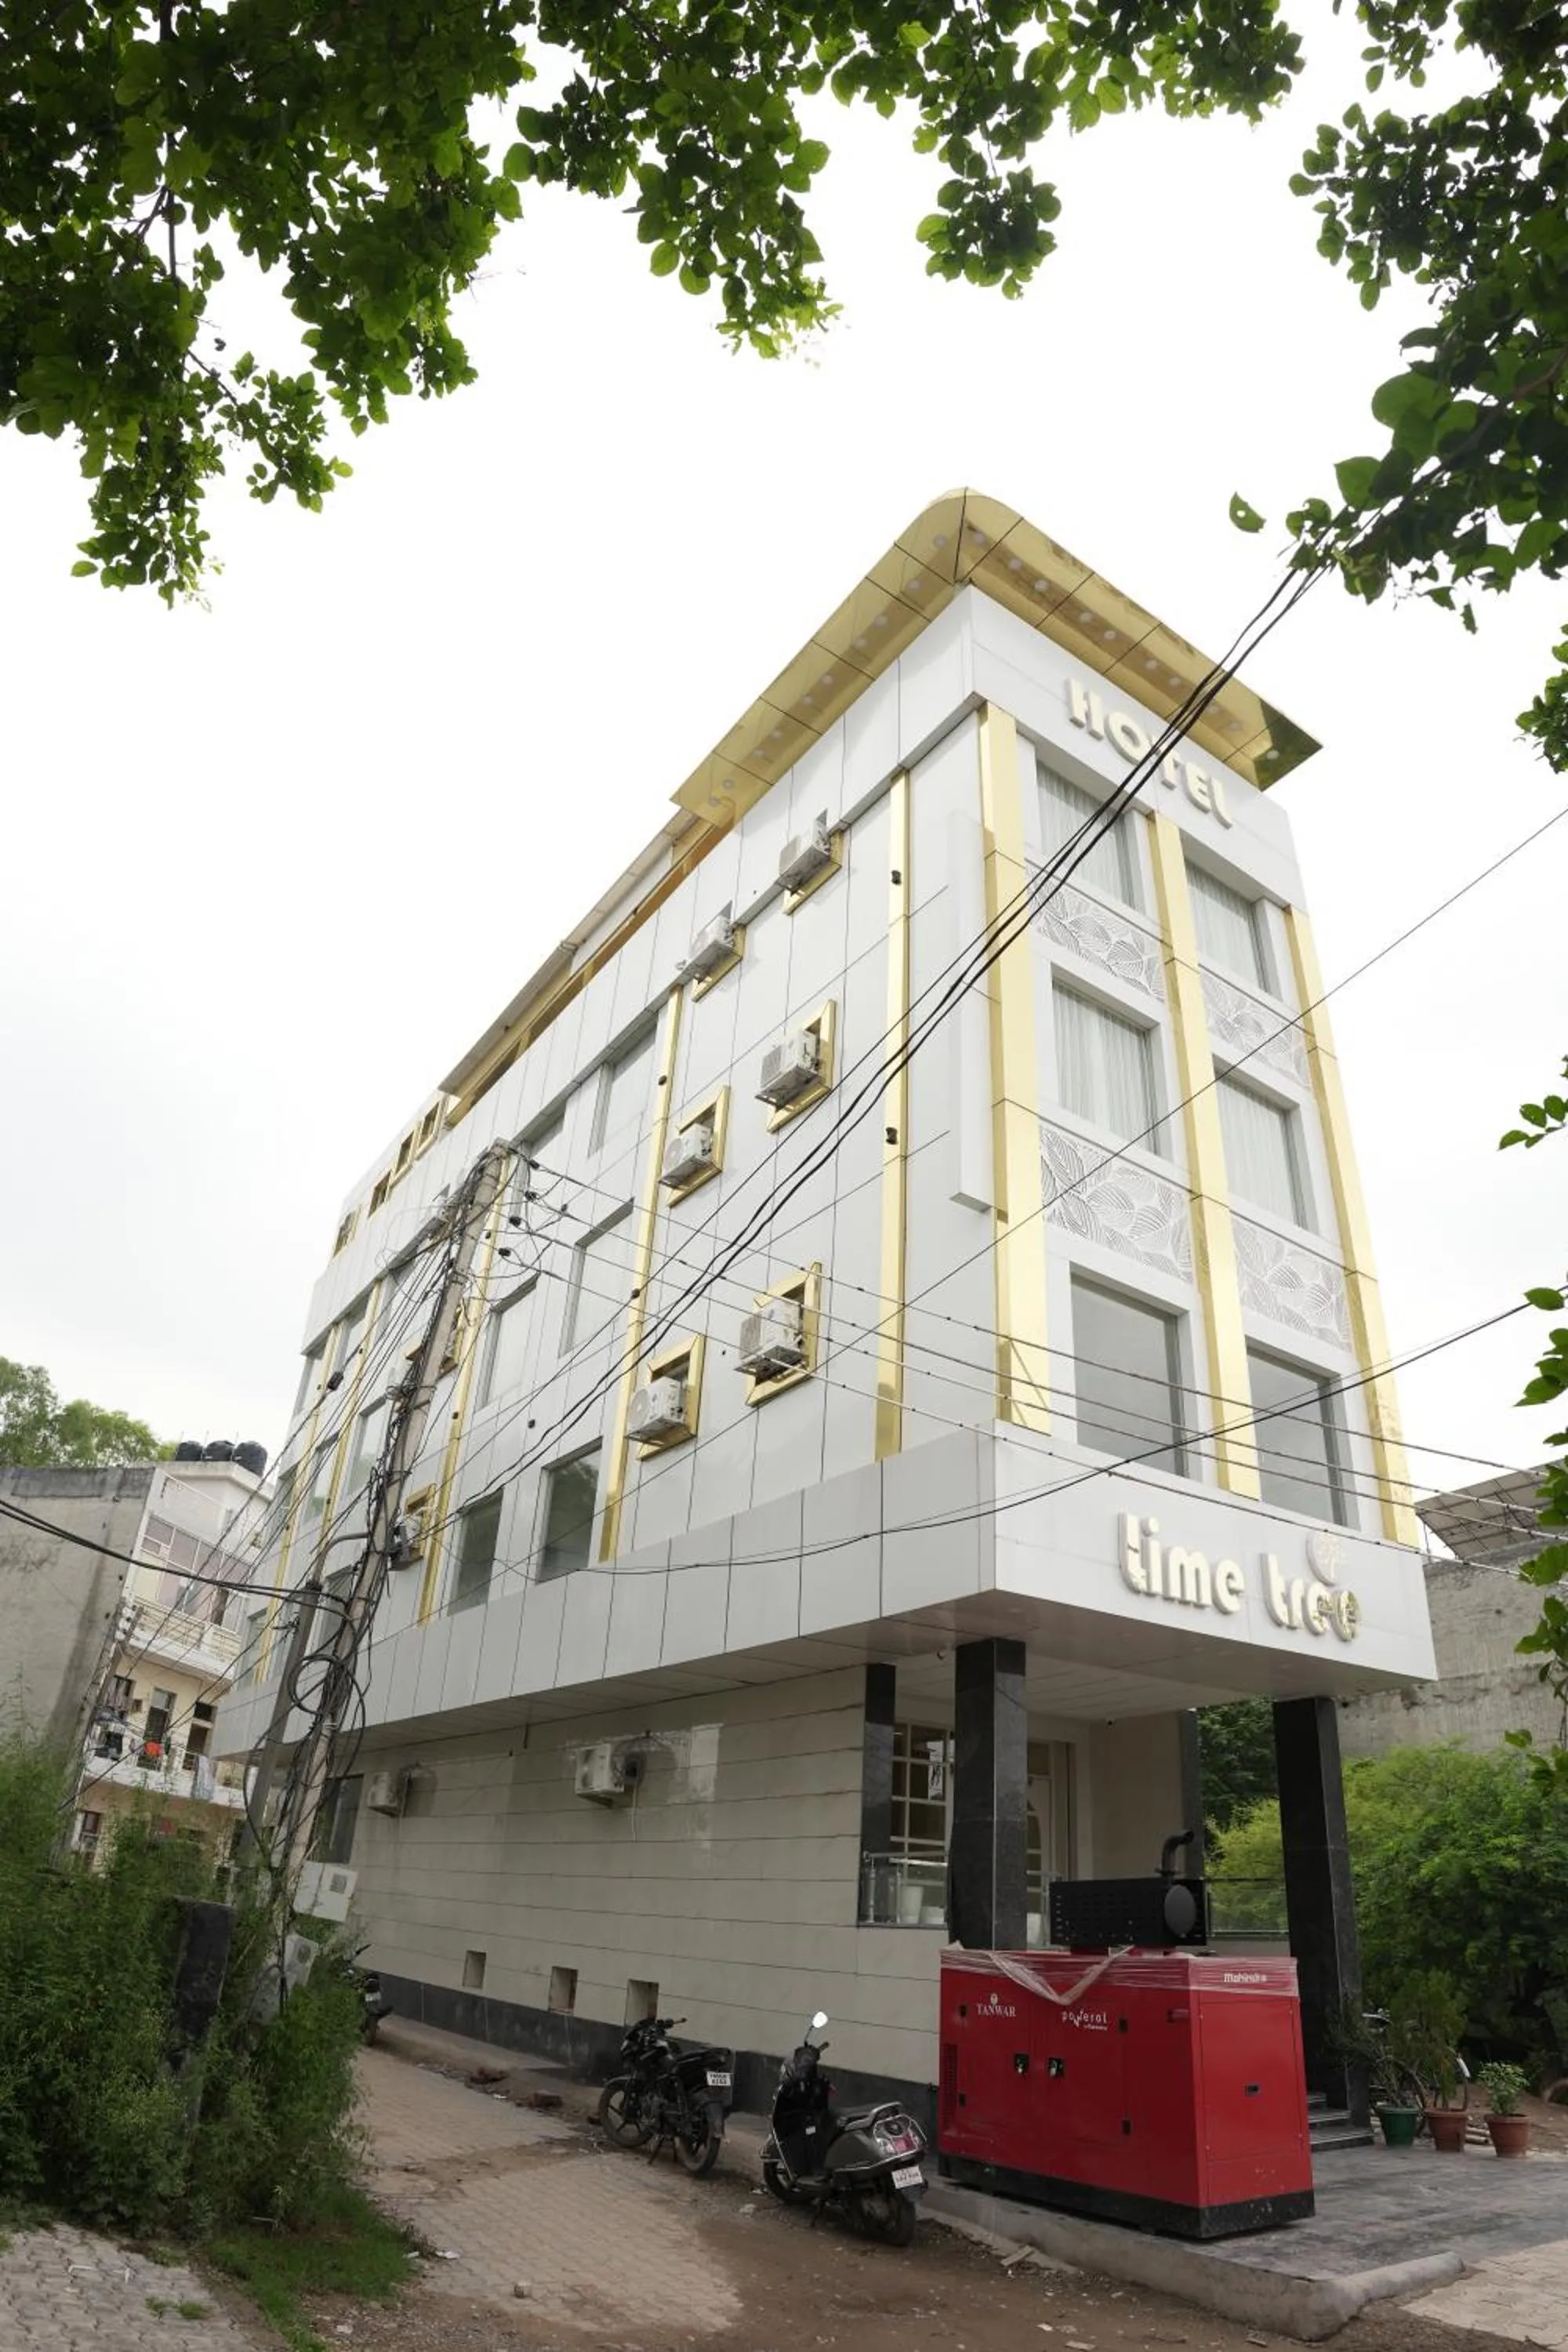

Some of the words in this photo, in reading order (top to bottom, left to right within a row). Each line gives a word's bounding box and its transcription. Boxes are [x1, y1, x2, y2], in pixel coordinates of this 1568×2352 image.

[1065, 676, 1232, 830] HOTEL
[1118, 1512, 1245, 1615] lime
[1258, 1552, 1361, 1642] tree
